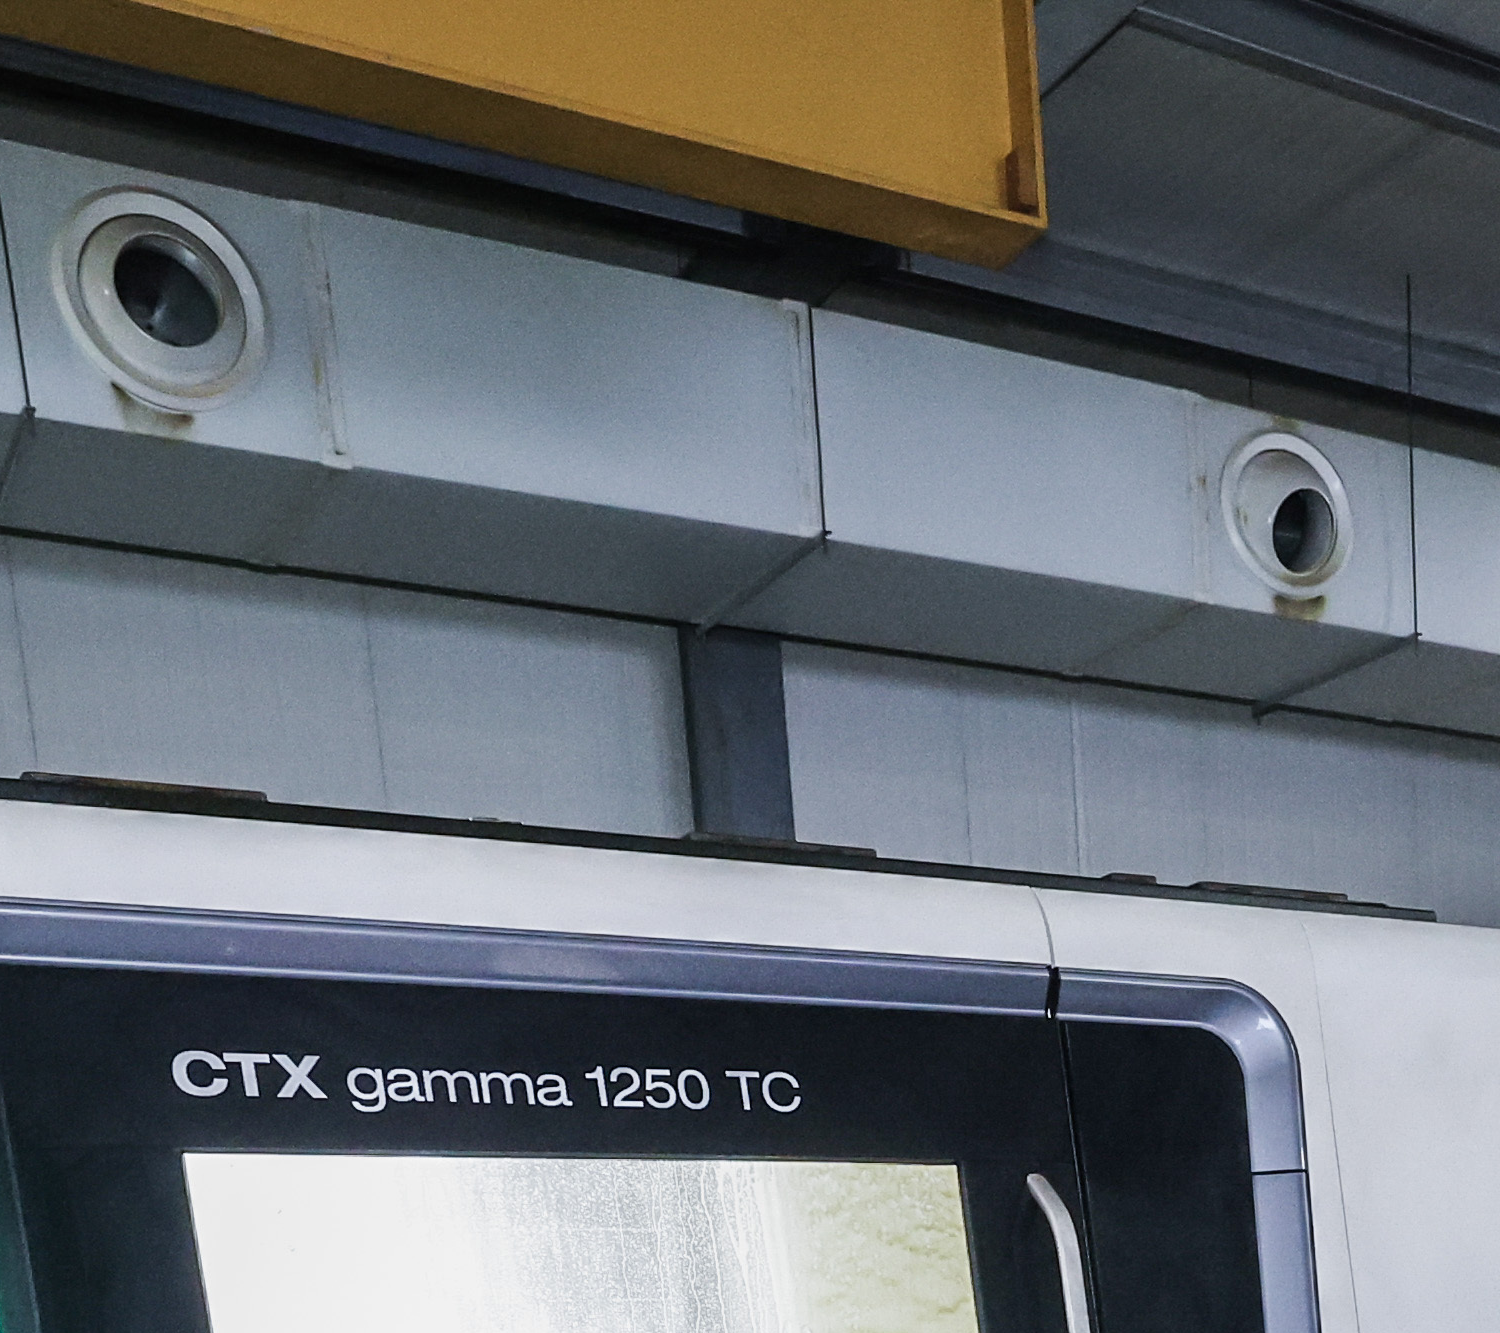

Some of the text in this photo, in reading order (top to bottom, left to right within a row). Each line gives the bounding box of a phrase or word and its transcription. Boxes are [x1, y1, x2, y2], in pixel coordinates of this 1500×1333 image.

[171, 1050, 802, 1113] CTX gamma 1250 TC
